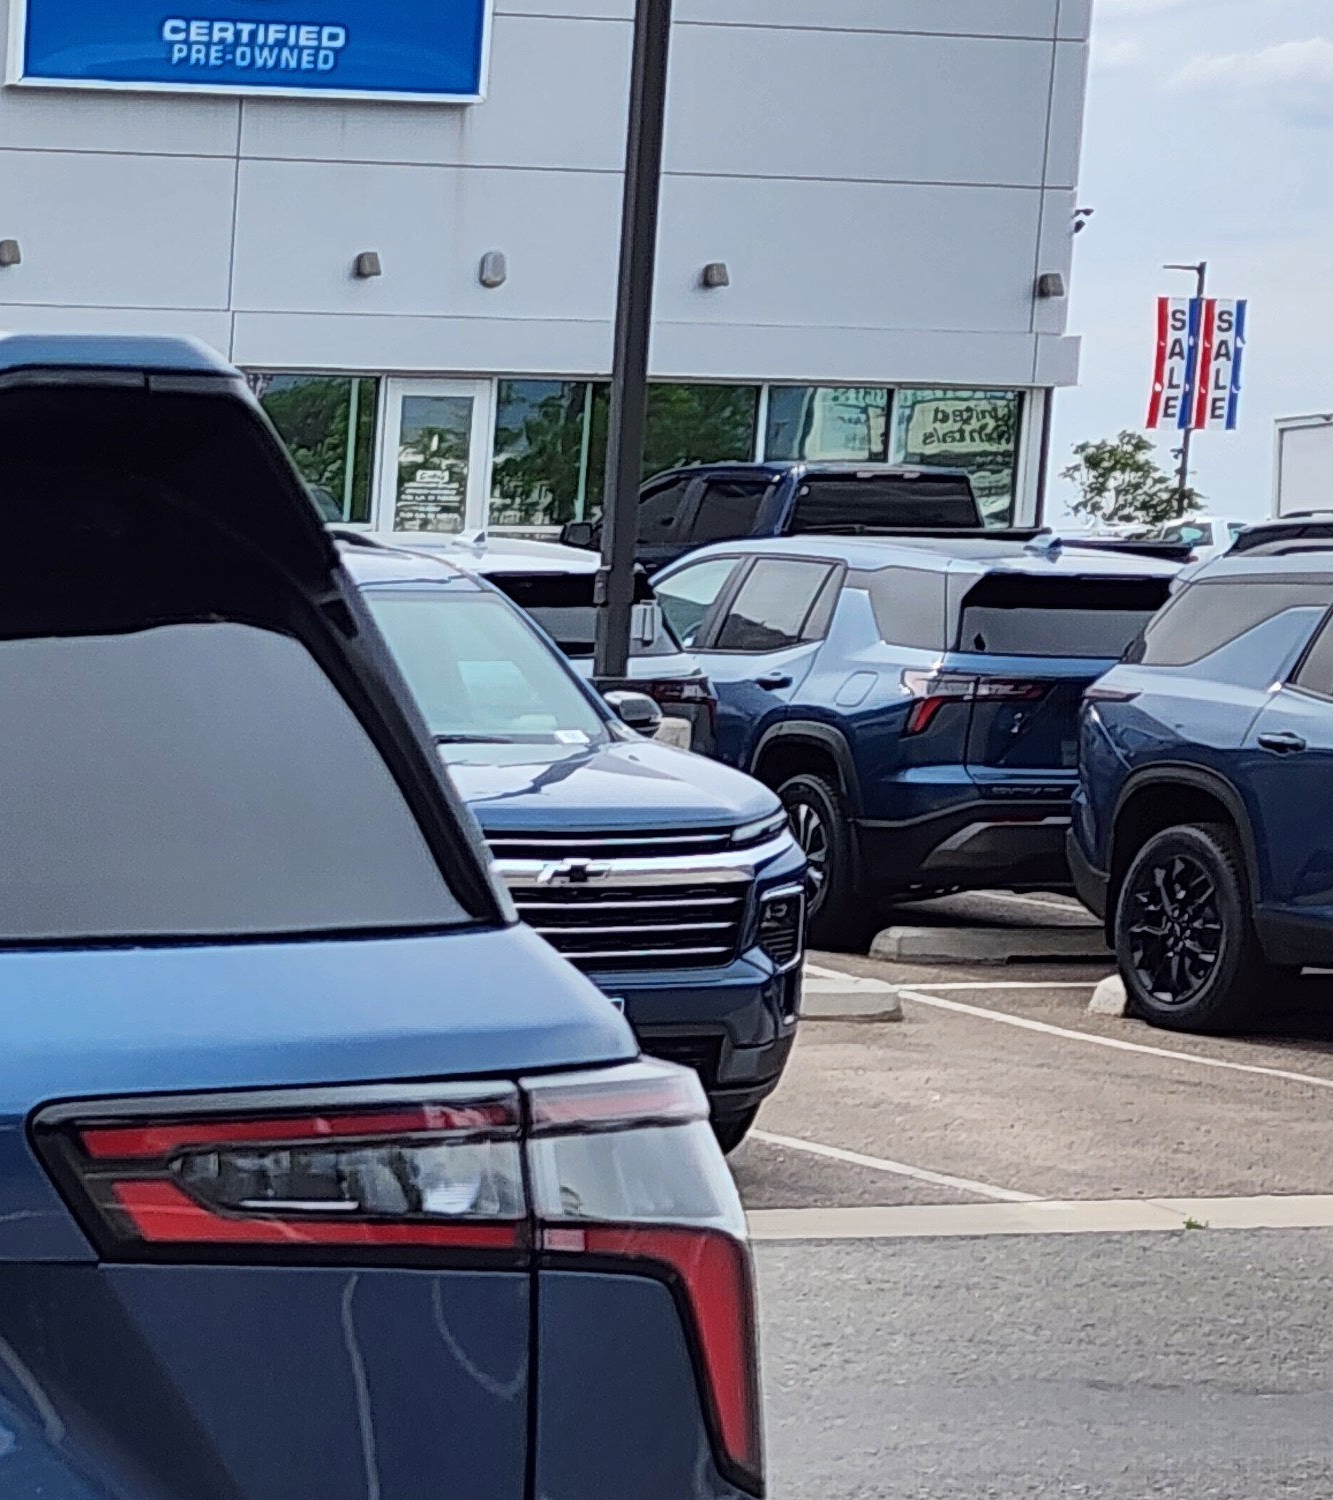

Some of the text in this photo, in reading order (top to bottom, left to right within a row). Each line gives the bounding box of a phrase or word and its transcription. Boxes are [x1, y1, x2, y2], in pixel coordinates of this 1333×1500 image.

[162, 18, 346, 48] CERTIFIED
[171, 44, 335, 71] PRE-OWNED
[1162, 308, 1187, 418] SALE
[1209, 309, 1233, 419] SALE
